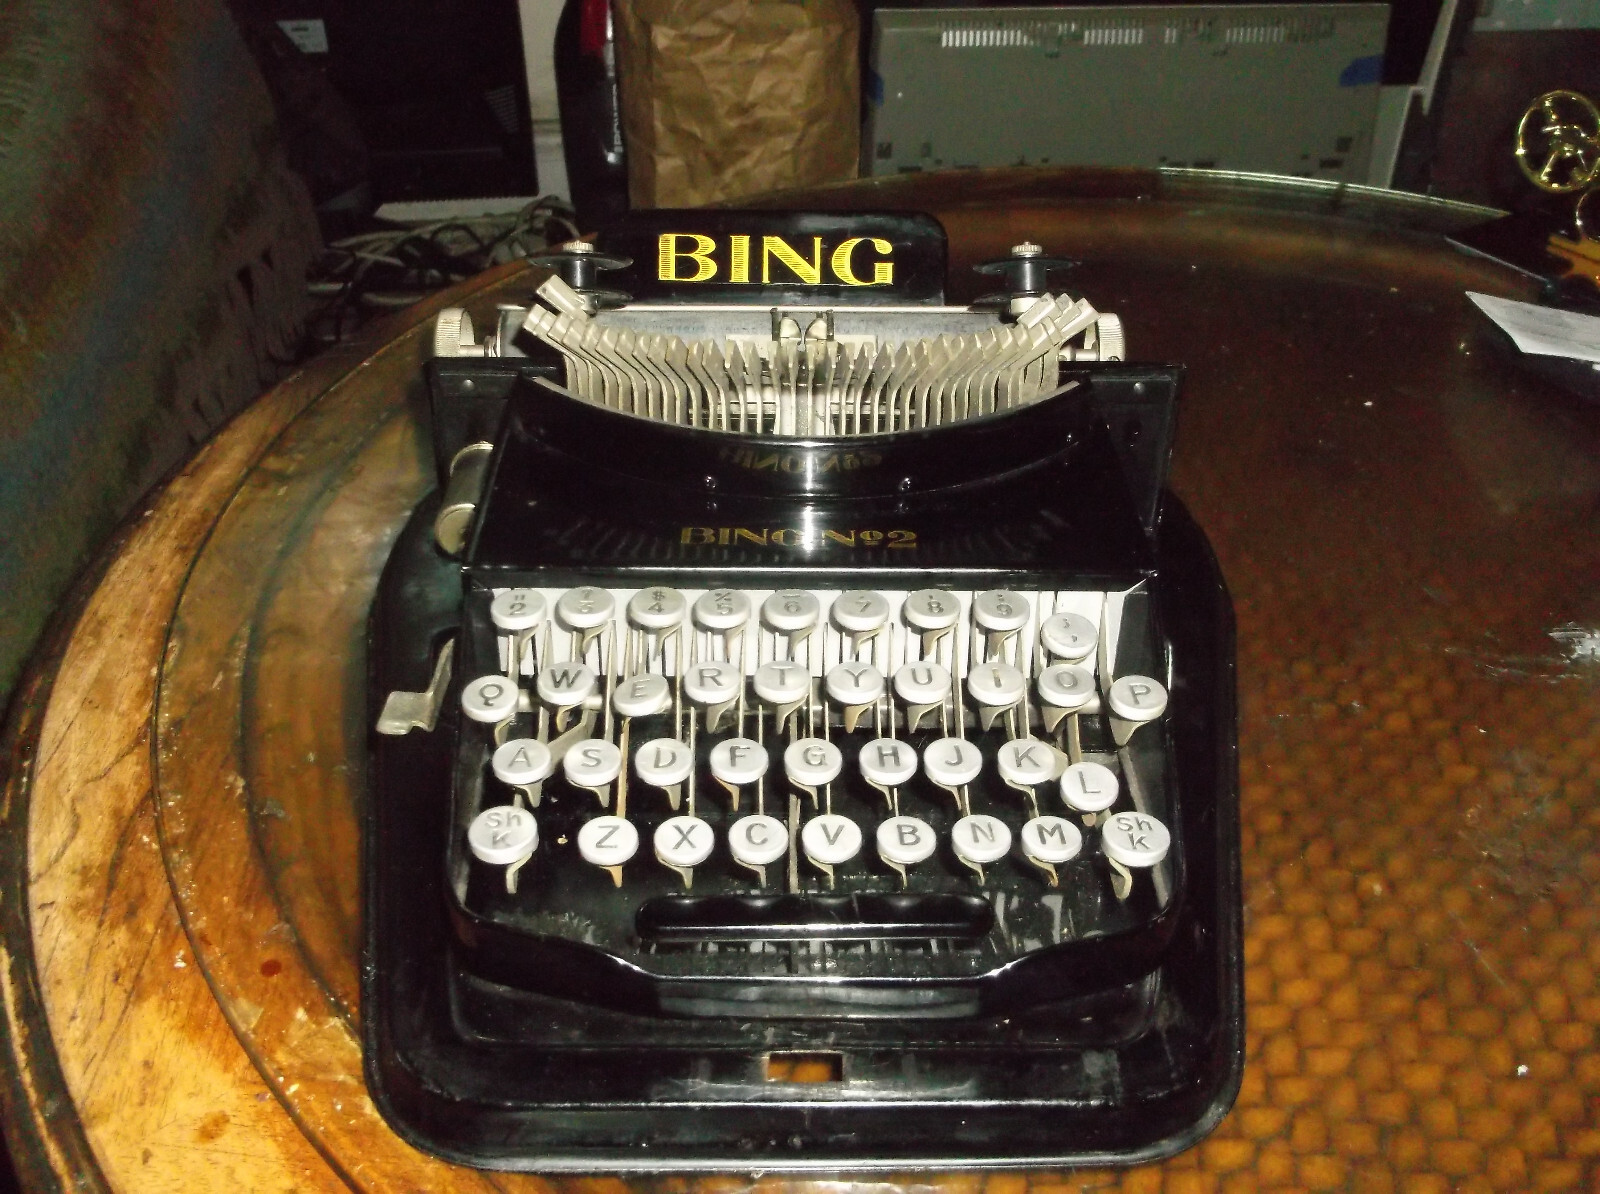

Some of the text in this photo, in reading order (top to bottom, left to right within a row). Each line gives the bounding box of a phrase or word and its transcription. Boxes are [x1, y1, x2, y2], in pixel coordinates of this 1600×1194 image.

[658, 233, 894, 286] BING
[509, 602, 527, 616] 2
[648, 602, 664, 613] 4
[716, 602, 733, 615] 5
[784, 600, 801, 613] 6
[855, 600, 871, 613] 7
[927, 600, 943, 613] 8
[550, 668, 582, 689] W
[699, 667, 722, 687] R
[770, 667, 794, 686] T
[843, 667, 868, 688] Y
[911, 667, 933, 686] U
[992, 668, 1003, 689] I
[1056, 671, 1079, 688] O
[479, 683, 504, 707] Q
[631, 679, 653, 700] E
[1130, 684, 1152, 706] P
[508, 746, 532, 768] A
[582, 747, 602, 768] S
[653, 747, 677, 769] D
[730, 745, 751, 768] F
[803, 745, 827, 767] G
[876, 745, 900, 768] H
[944, 745, 964, 766] J
[1013, 746, 1041, 768] K
[1079, 771, 1102, 795] L
[485, 811, 523, 828] Sh
[1117, 812, 1153, 832] Sh
[492, 830, 511, 848] K
[595, 825, 620, 849] Z
[672, 824, 699, 850] X
[745, 823, 768, 846] C
[820, 823, 845, 846] V
[897, 824, 921, 846] B
[970, 821, 996, 844] N
[1036, 823, 1067, 846] M
[1128, 832, 1151, 850] K
